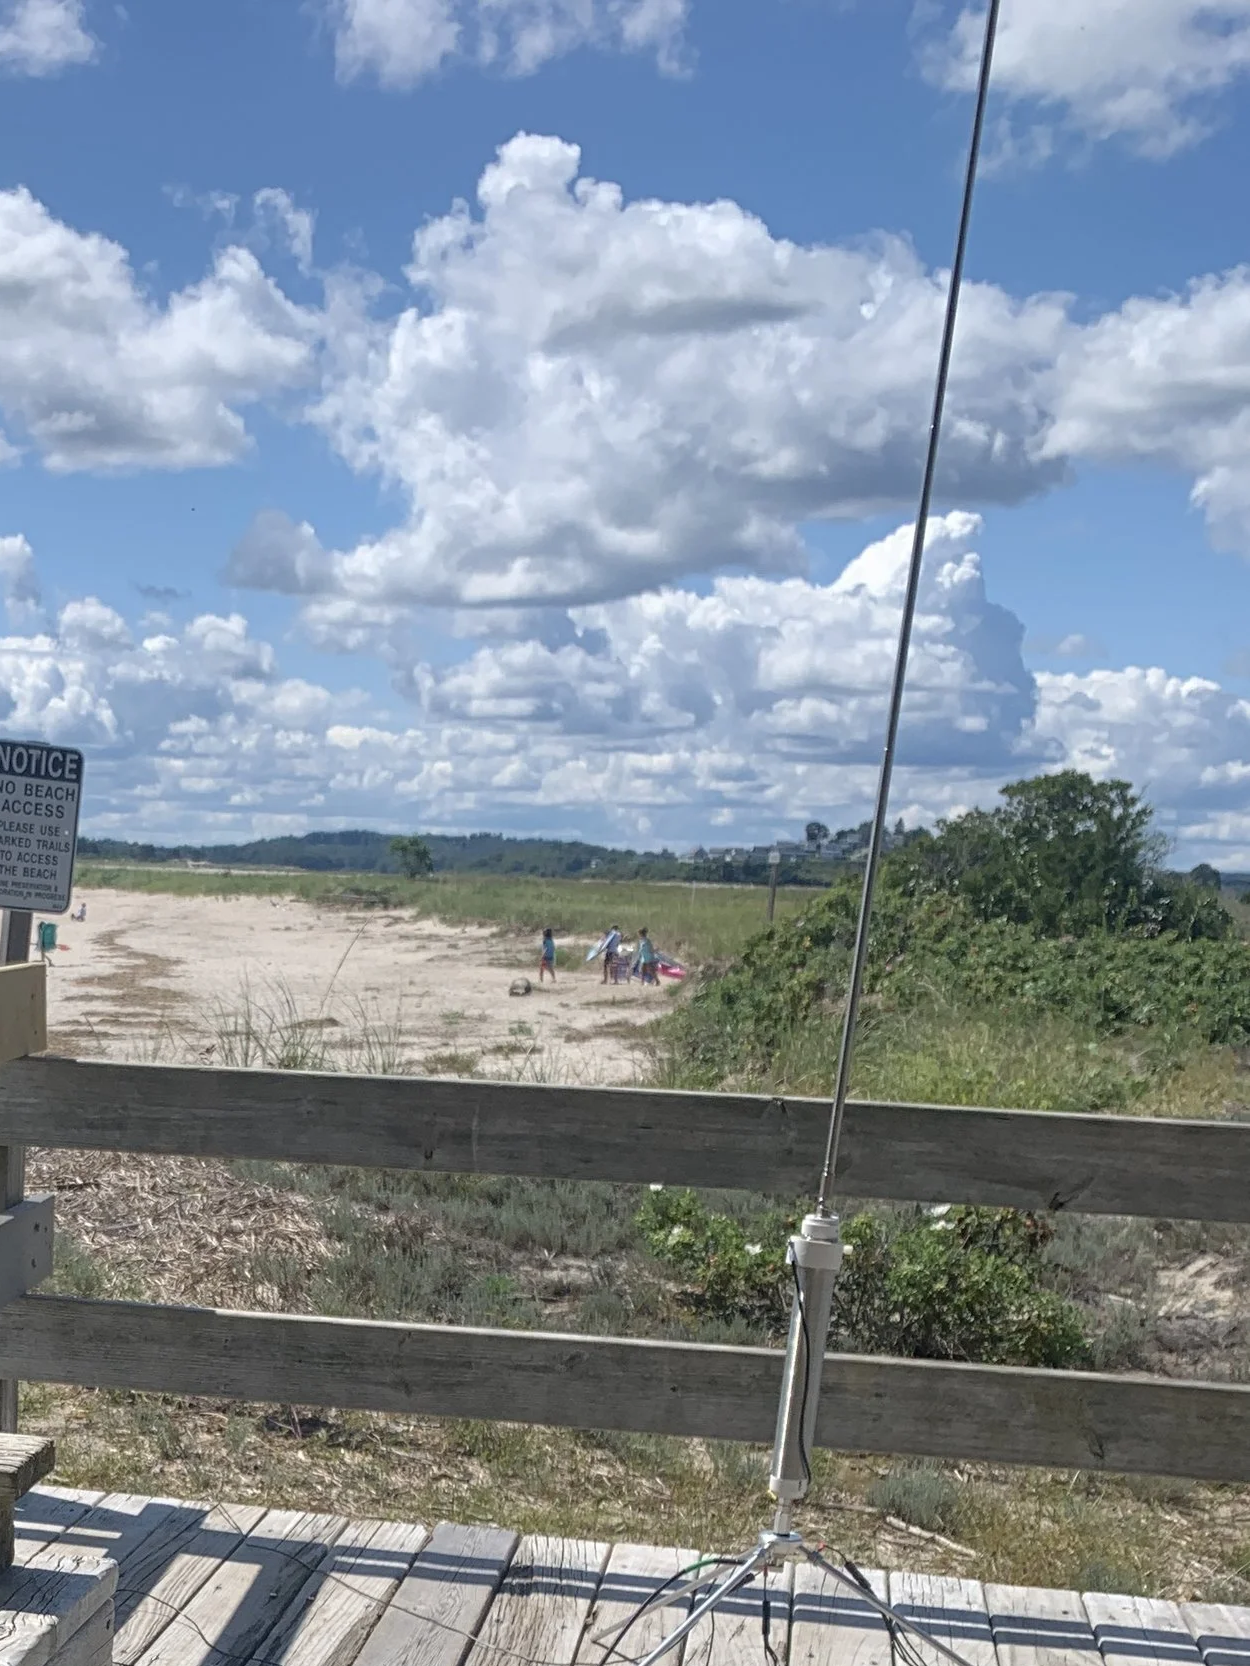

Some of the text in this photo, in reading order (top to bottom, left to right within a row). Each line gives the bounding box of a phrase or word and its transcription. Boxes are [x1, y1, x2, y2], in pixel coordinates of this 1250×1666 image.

[24, 783, 76, 802] BEACH
[1, 799, 65, 819] ACCESS
[40, 824, 61, 837] USE
[36, 839, 70, 853] TRAILS
[0, 850, 59, 866] TO ACCESS
[0, 864, 57, 881] THE BEACH
